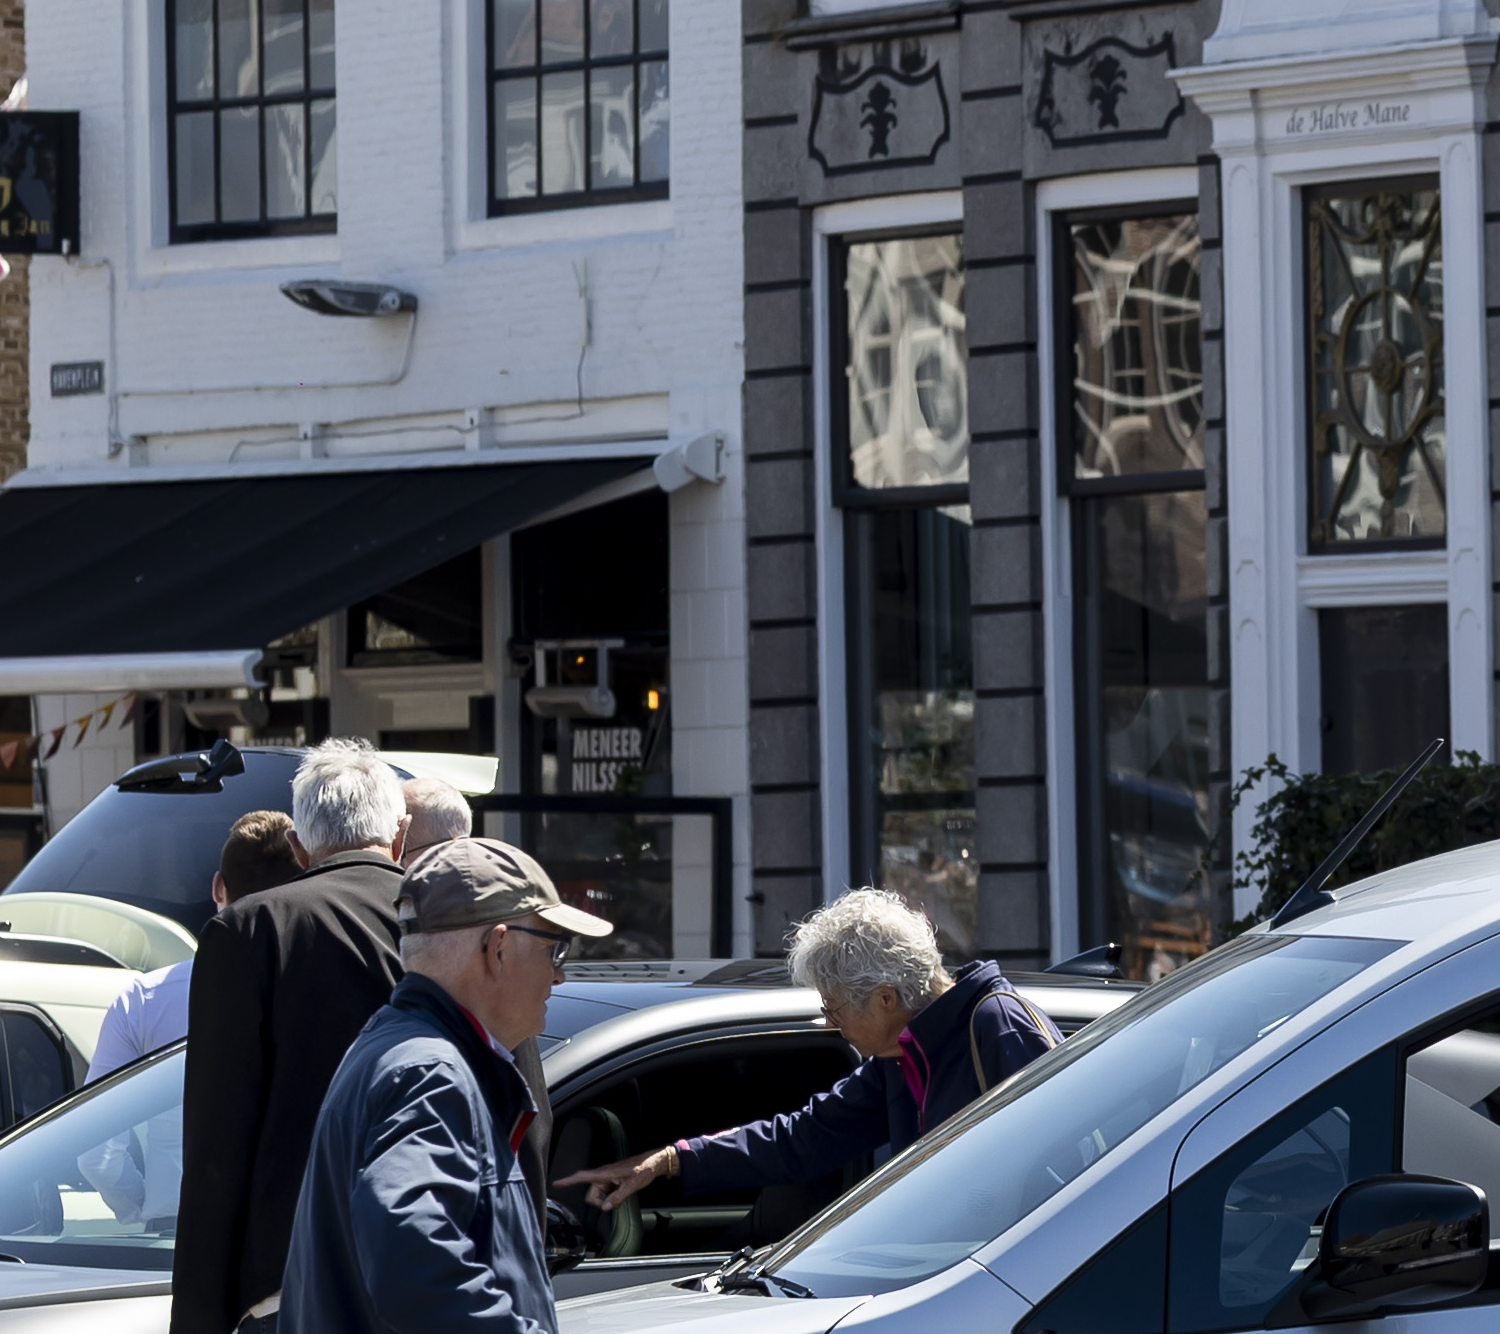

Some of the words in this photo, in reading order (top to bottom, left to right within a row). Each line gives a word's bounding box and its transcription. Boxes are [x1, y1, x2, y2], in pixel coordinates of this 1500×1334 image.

[1285, 107, 1305, 134] de
[1309, 102, 1359, 132] Halve
[1363, 103, 1410, 126] Mane
[573, 728, 642, 758] MENEER
[572, 762, 641, 792] NILSS
